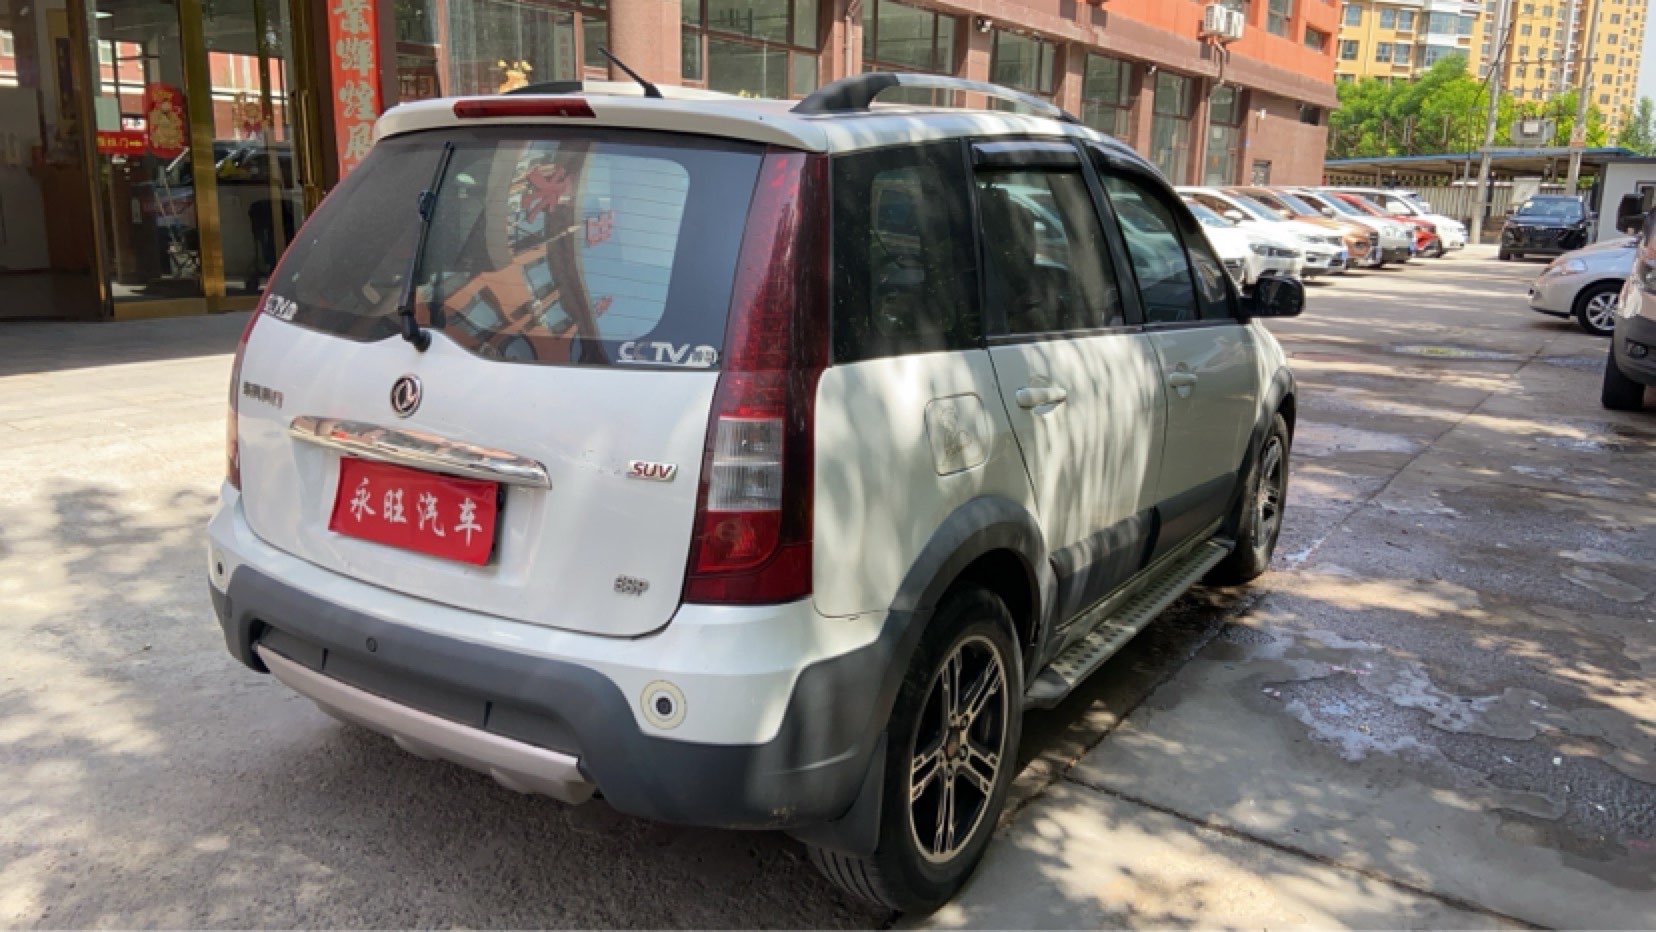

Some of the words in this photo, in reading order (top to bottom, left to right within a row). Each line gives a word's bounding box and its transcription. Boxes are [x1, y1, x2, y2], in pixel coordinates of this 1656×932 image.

[633, 461, 673, 479] SUV
[350, 477, 482, 546] 永旺汽车
